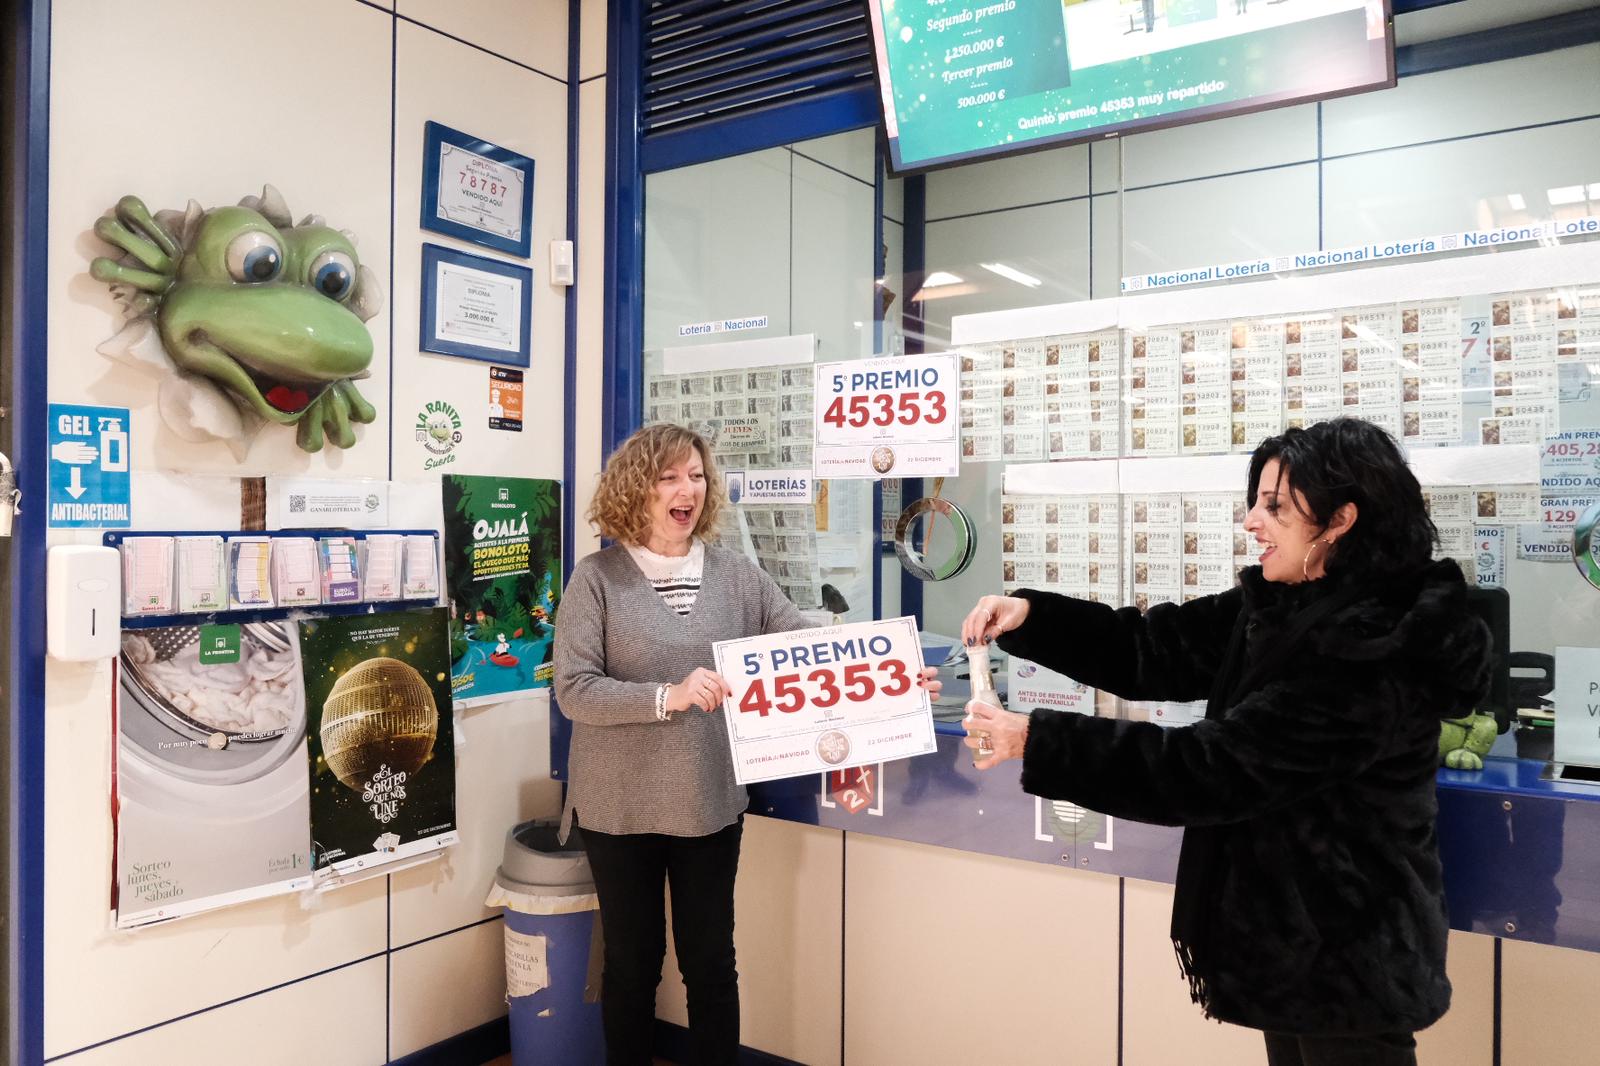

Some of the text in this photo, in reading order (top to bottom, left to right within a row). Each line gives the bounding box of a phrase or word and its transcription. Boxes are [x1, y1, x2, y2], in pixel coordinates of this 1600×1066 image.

[926, 0, 1015, 32] Segundo premio
[996, 35, 1005, 48] €
[942, 57, 1013, 82] Tercer premio
[957, 89, 1005, 109] 500.000 €
[1018, 110, 1055, 130] Quinto
[1058, 104, 1098, 126] premio
[1138, 90, 1164, 106] muy
[1167, 80, 1225, 102] repartido
[459, 172, 507, 198] 78787
[462, 189, 489, 202] VENDIDO
[1464, 218, 1600, 246] Nacional Lote
[1295, 246, 1368, 267] Nacional
[1147, 268, 1212, 287] Nacional
[679, 317, 767, 336] Lotería Nacional
[833, 368, 939, 393] 5º PREMIO
[425, 400, 462, 429] RANITA
[823, 390, 947, 428] 45353
[58, 414, 93, 436] GEL
[724, 418, 745, 426] TODOS
[724, 426, 752, 434] JUEVES
[1547, 442, 1600, 458] 405,2
[424, 454, 456, 471] Suerte
[749, 477, 807, 491] LOTERÍAS
[1541, 477, 1600, 488] NDIDO AQ
[52, 503, 129, 521] ANTIBACTERIAL
[1540, 499, 1569, 507] GRAN
[473, 511, 529, 540] OJALÁ
[474, 543, 531, 560] BONOLOTO,
[1524, 544, 1570, 553] VENDID
[473, 565, 515, 576] OPORTUNIDADES
[482, 558, 502, 567] JUEGO
[1477, 572, 1496, 583] QUÍ
[785, 630, 821, 641] VENDIDO
[743, 635, 892, 676] 5º PREMIO
[738, 658, 911, 718] 45353
[1017, 690, 1036, 698] ANTES
[1048, 692, 1082, 701] RETIRARSE
[1038, 699, 1075, 707] VENTANILLA
[158, 742, 172, 750] Por
[173, 740, 188, 750] muy
[189, 738, 208, 749] poco
[228, 732, 252, 743] puedes
[253, 730, 274, 742] lograr
[877, 732, 913, 745] DICIEMBRE
[779, 749, 810, 759] NAVIDAD
[362, 771, 406, 802] SORTEO
[373, 786, 406, 804] QUE NOS
[369, 800, 399, 824] UNE
[132, 861, 171, 873] Sorteo
[134, 880, 171, 898] jueves
[144, 885, 184, 902] sábado
